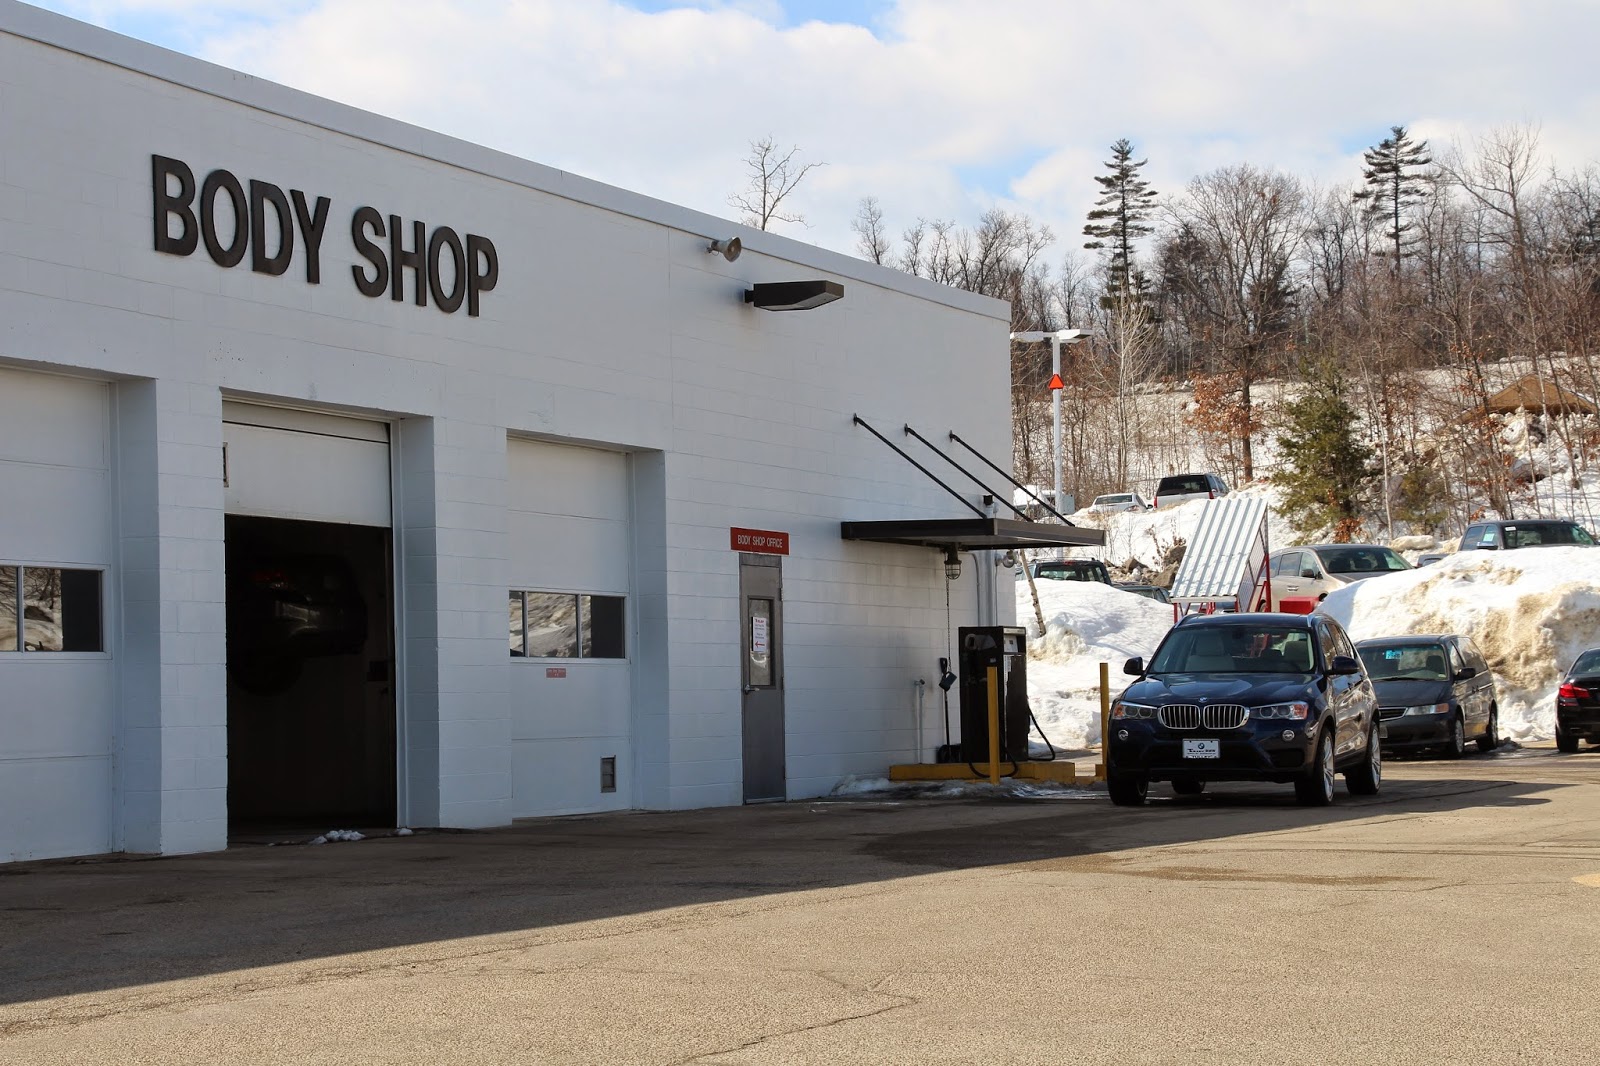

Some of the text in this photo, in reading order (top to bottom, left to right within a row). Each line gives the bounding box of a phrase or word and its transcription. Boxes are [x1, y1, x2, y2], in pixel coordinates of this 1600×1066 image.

[152, 154, 499, 317] BODY SHOP
[738, 535, 783, 548] BODY SHOP OFFICE
